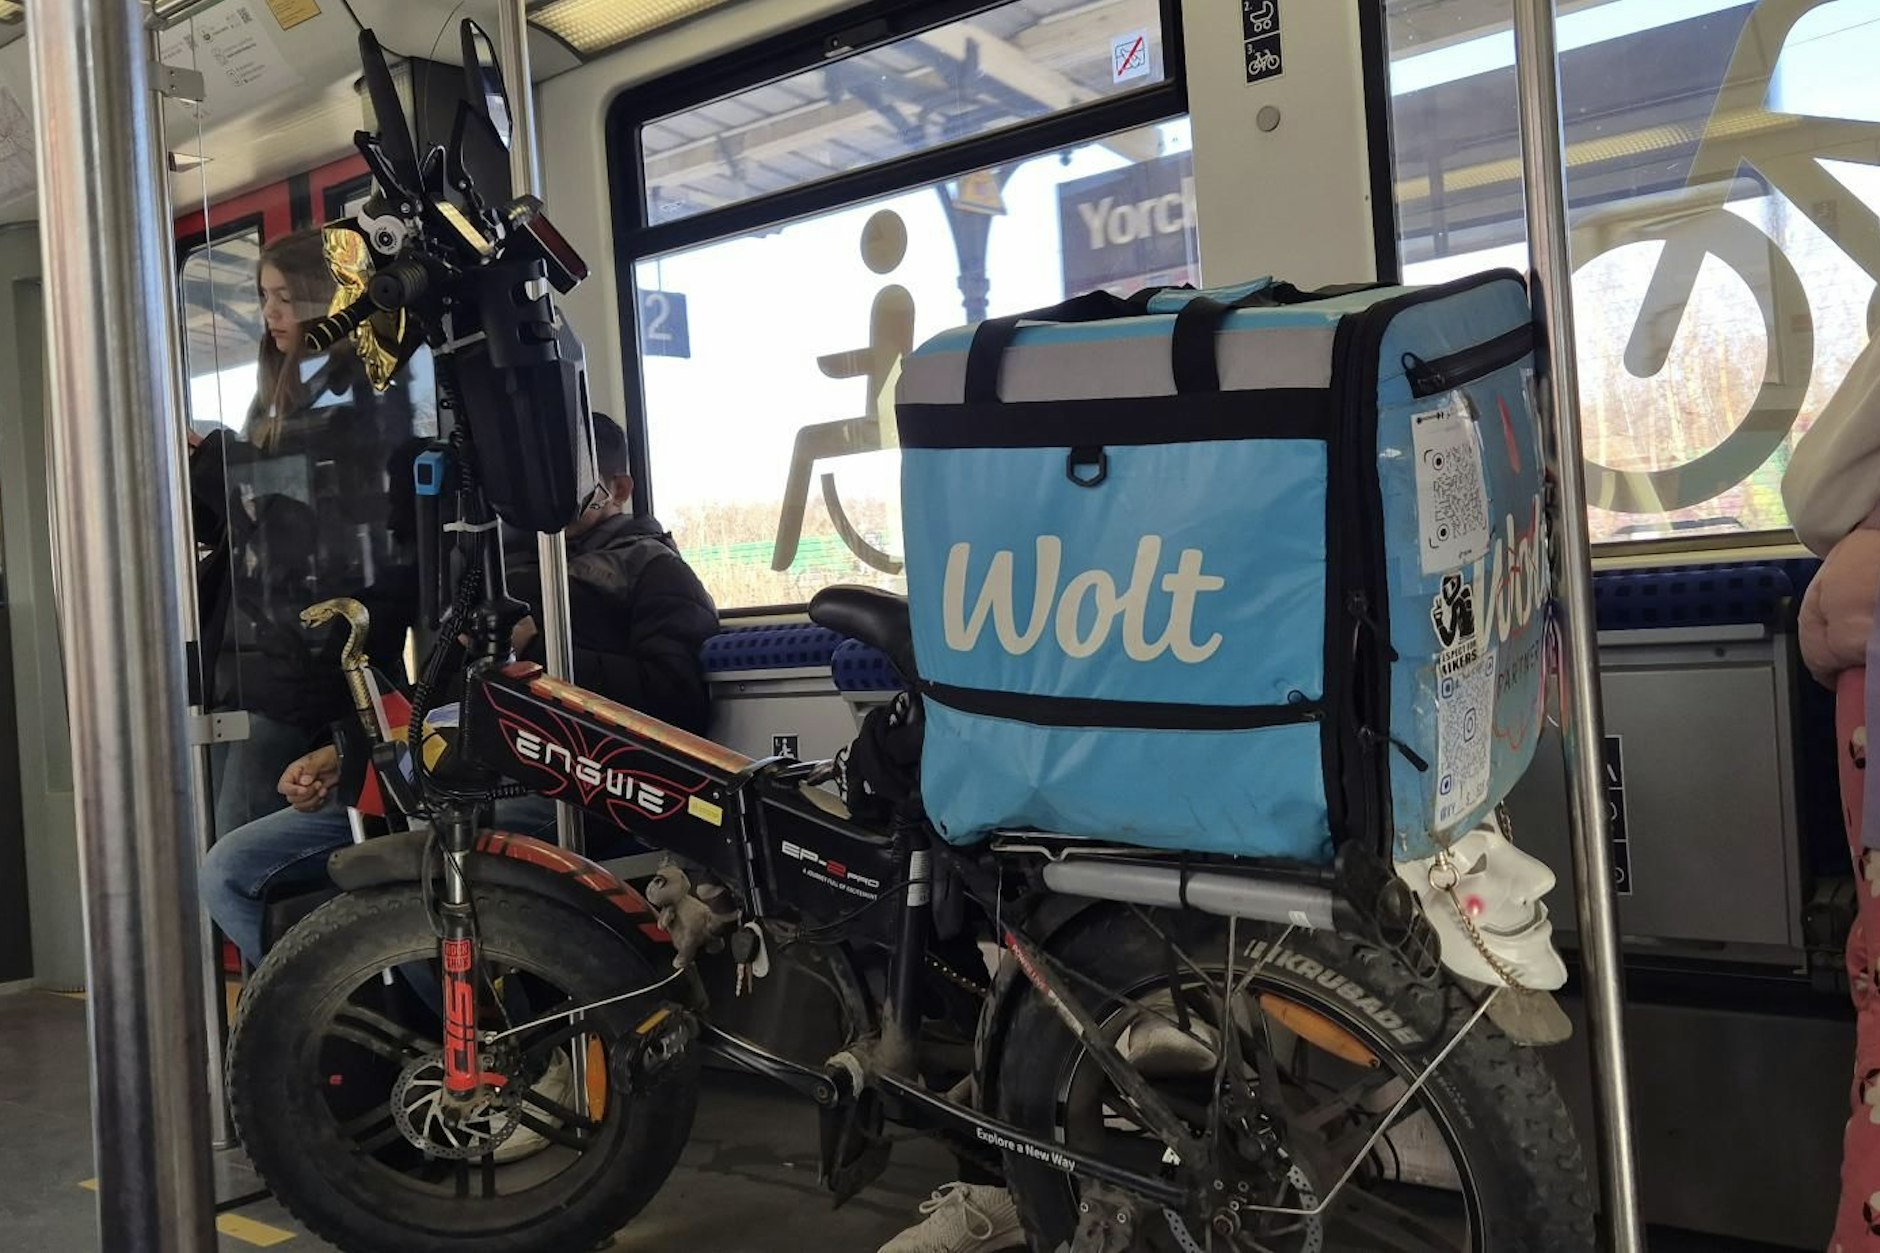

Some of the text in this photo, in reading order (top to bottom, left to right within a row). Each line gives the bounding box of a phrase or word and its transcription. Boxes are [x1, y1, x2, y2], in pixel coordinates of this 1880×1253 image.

[645, 293, 672, 340] 2
[943, 534, 1225, 663] Wolt
[976, 1127, 1076, 1172] Explore a New Way
